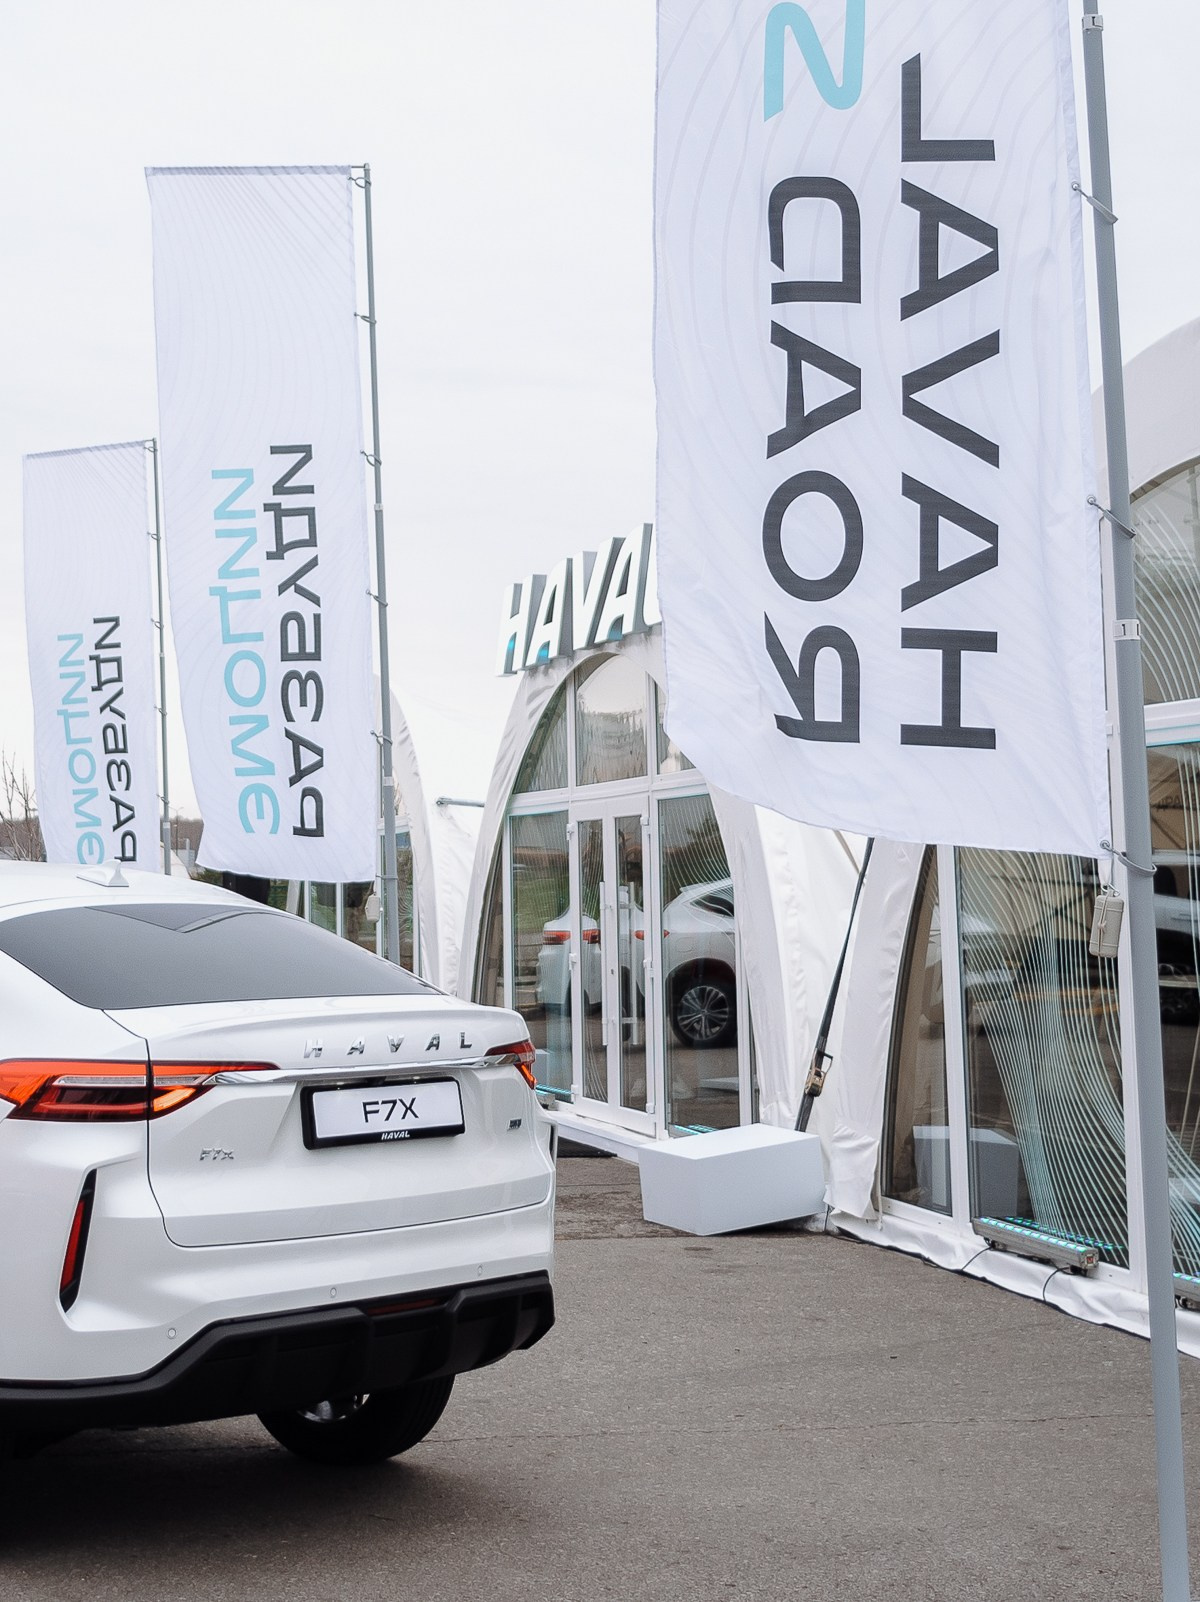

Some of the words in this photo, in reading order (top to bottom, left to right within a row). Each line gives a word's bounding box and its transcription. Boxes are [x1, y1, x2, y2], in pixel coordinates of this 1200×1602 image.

[302, 1031, 473, 1059] HAVAL
[362, 1096, 419, 1123] F7X
[381, 1130, 411, 1141] HAVAL
